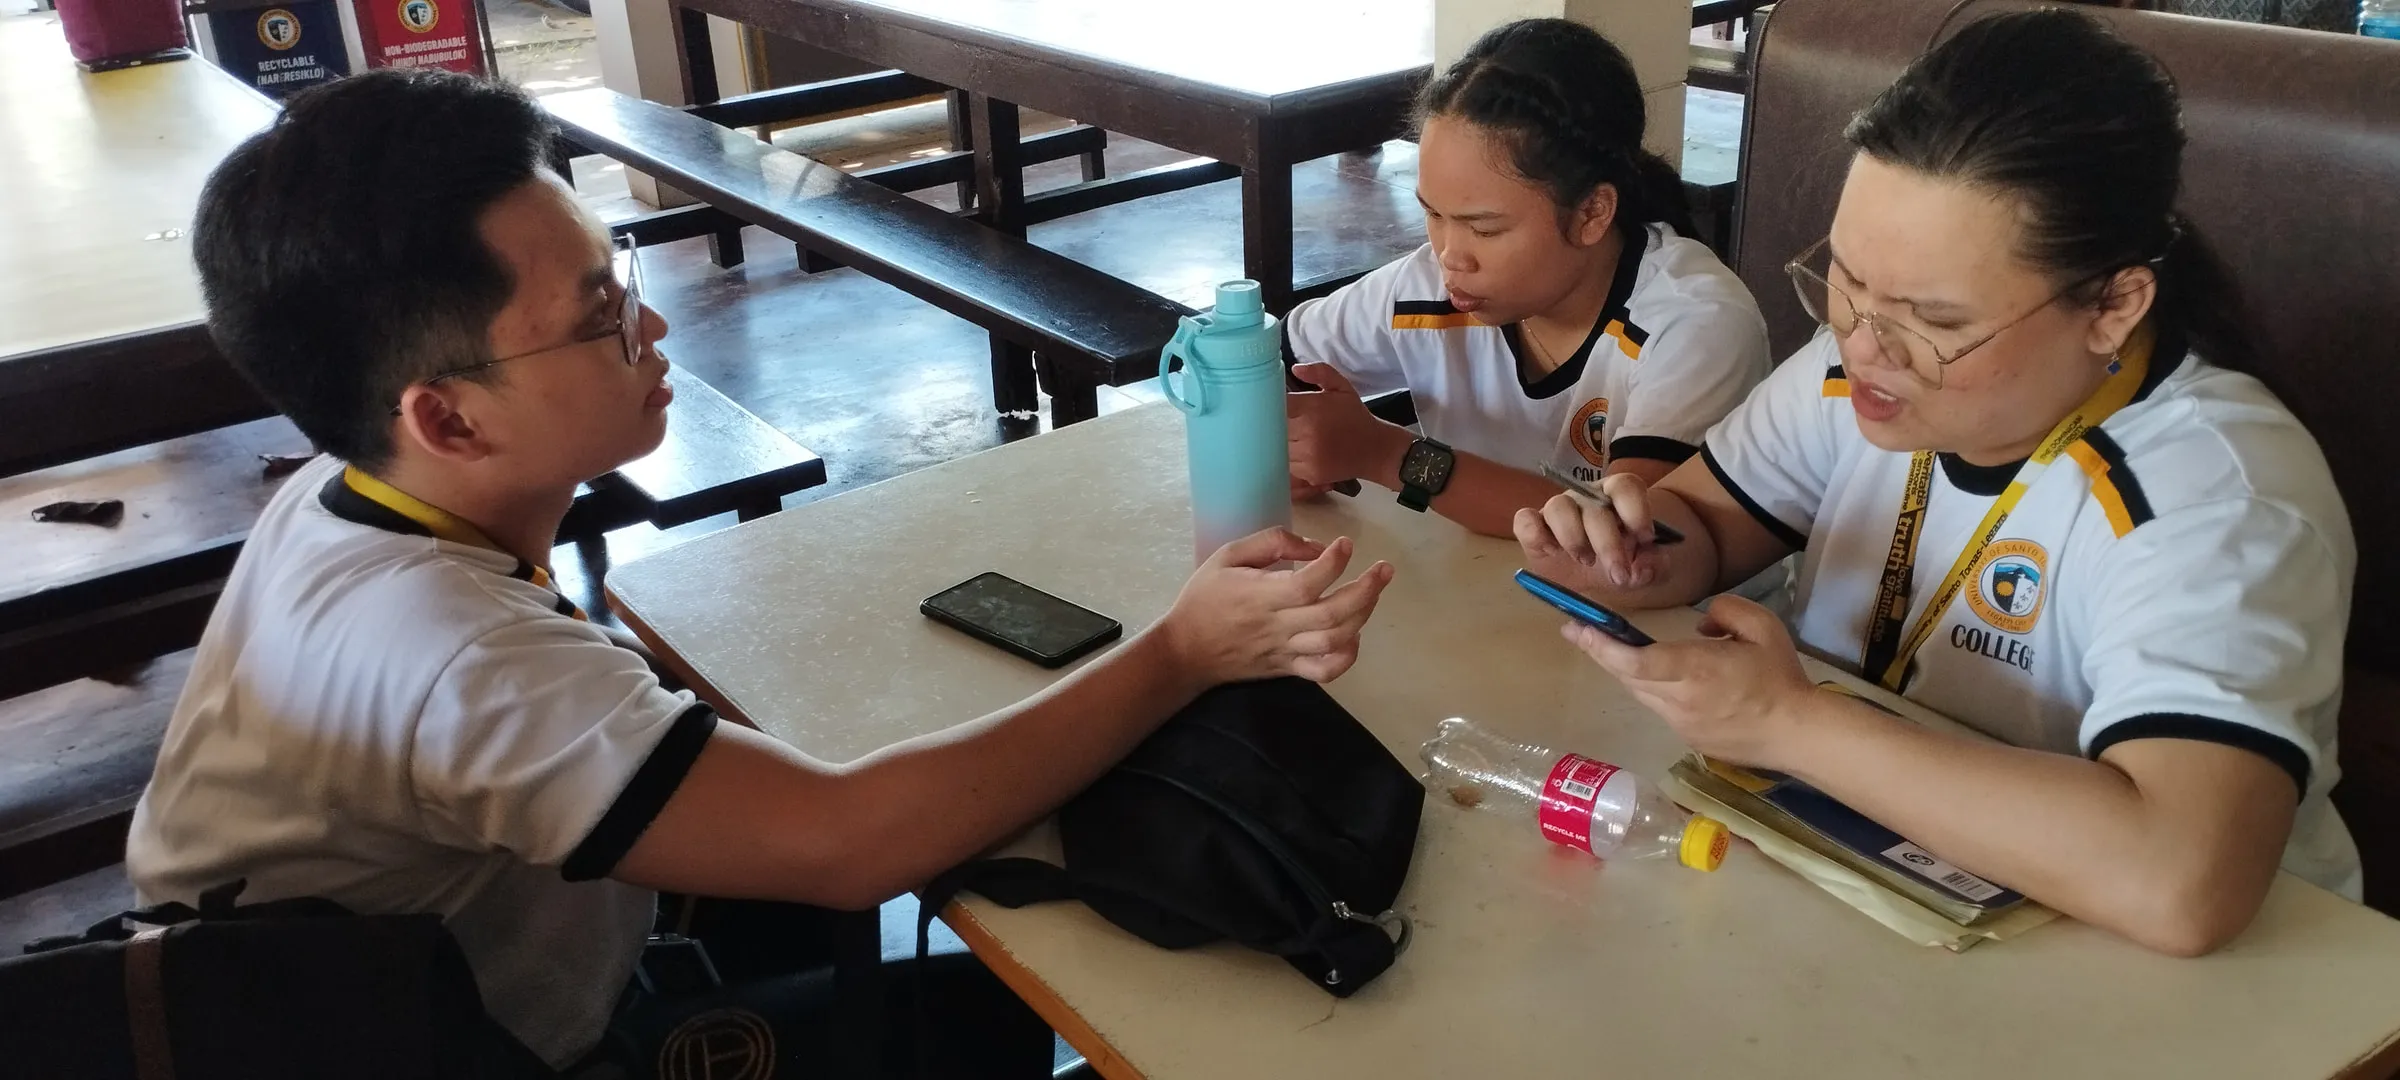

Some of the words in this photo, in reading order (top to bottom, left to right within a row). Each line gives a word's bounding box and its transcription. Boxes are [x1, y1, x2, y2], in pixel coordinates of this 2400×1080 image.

[384, 36, 468, 57] NON-BIODEGRADABLE
[258, 55, 316, 72] RECYCLABLE
[1916, 450, 1934, 506] veritatis
[1887, 516, 1913, 571] truth
[1989, 546, 2001, 558] OF
[2004, 544, 2039, 557] SANTO
[1894, 564, 1910, 594] love
[1939, 579, 1962, 608] Santo
[1874, 575, 1897, 642] gratitude
[1543, 822, 1575, 838] RECYCLE
[1575, 833, 1588, 843] ME
